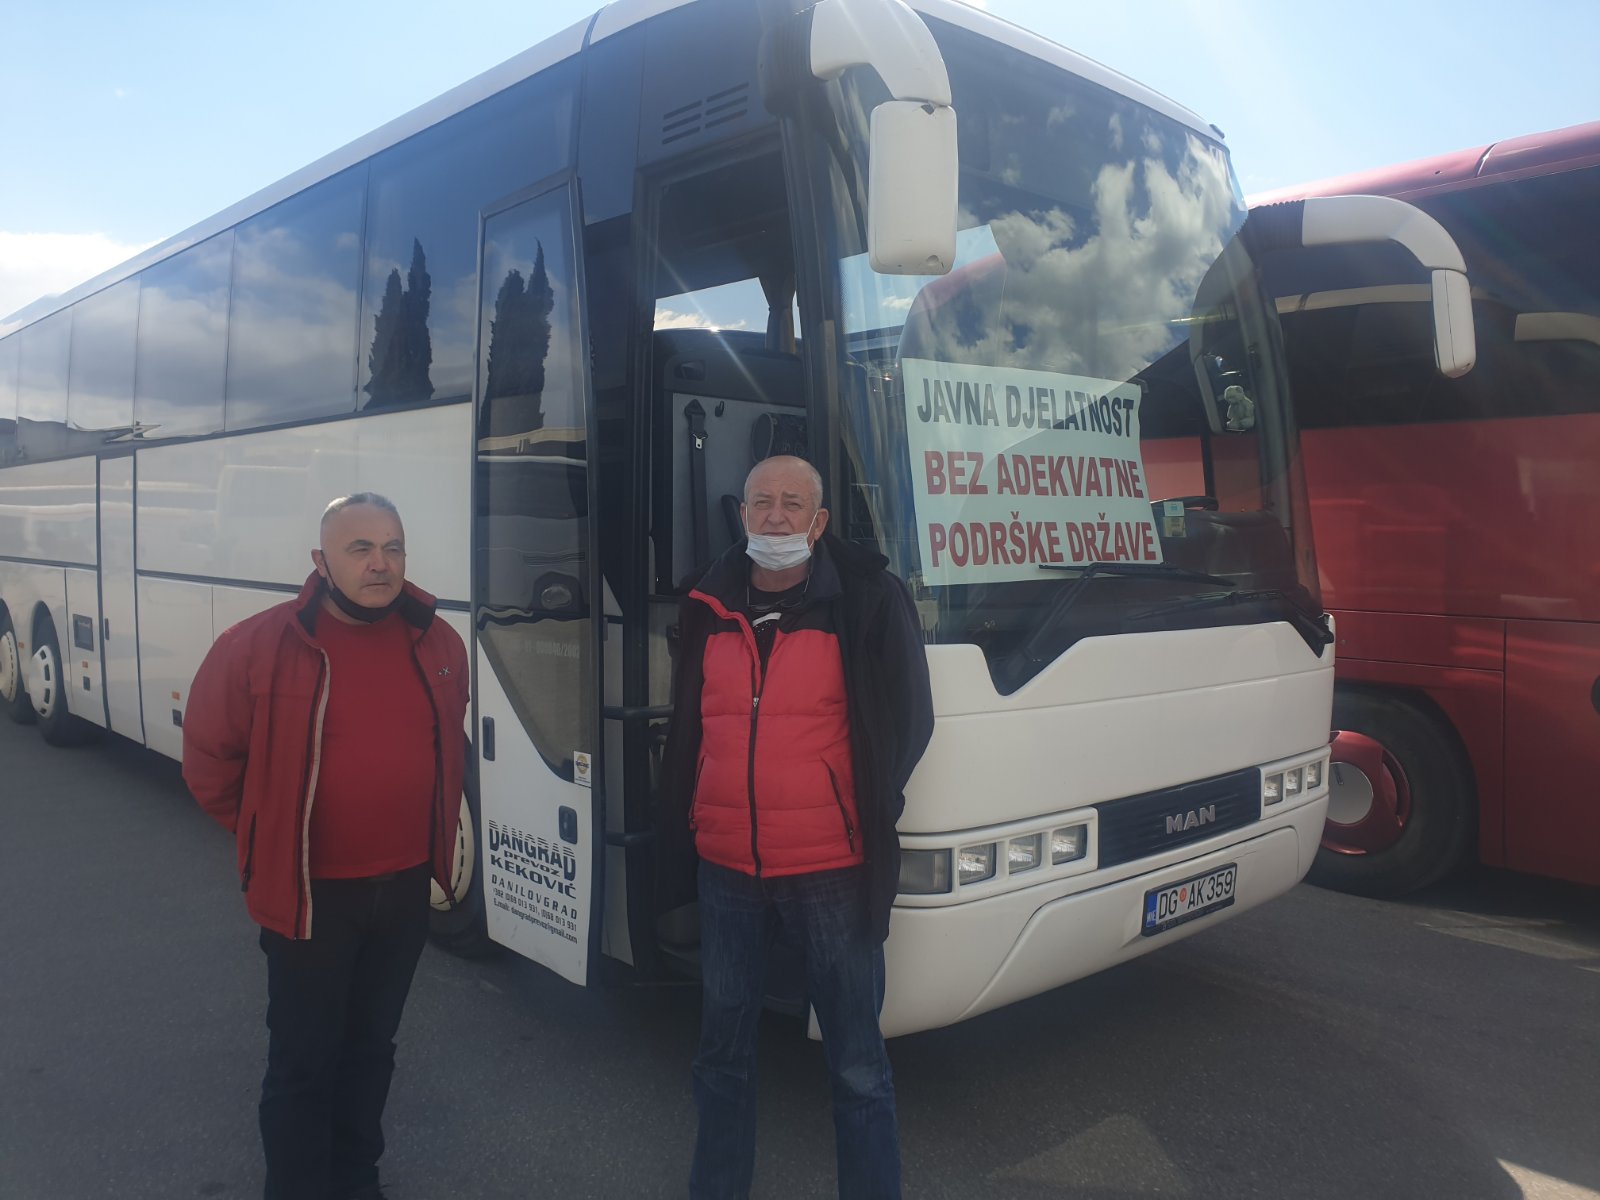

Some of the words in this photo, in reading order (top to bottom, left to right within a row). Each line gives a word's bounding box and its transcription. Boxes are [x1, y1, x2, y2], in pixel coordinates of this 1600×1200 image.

[917, 378, 999, 427] JAVNA
[1005, 385, 1135, 438] DJELATNOST
[924, 451, 988, 495] BEZ
[997, 454, 1144, 498] ADEKVATNE
[928, 511, 1063, 567] PODRŠKE
[1066, 512, 1156, 562] DRŽAVE
[1166, 804, 1216, 835] MAN
[488, 819, 576, 881] DANGRAD
[503, 850, 560, 877] prevoz
[490, 855, 577, 899] KEKOVIĆ
[491, 874, 577, 920] DANILOVGRAD
[1159, 889, 1178, 920] DG
